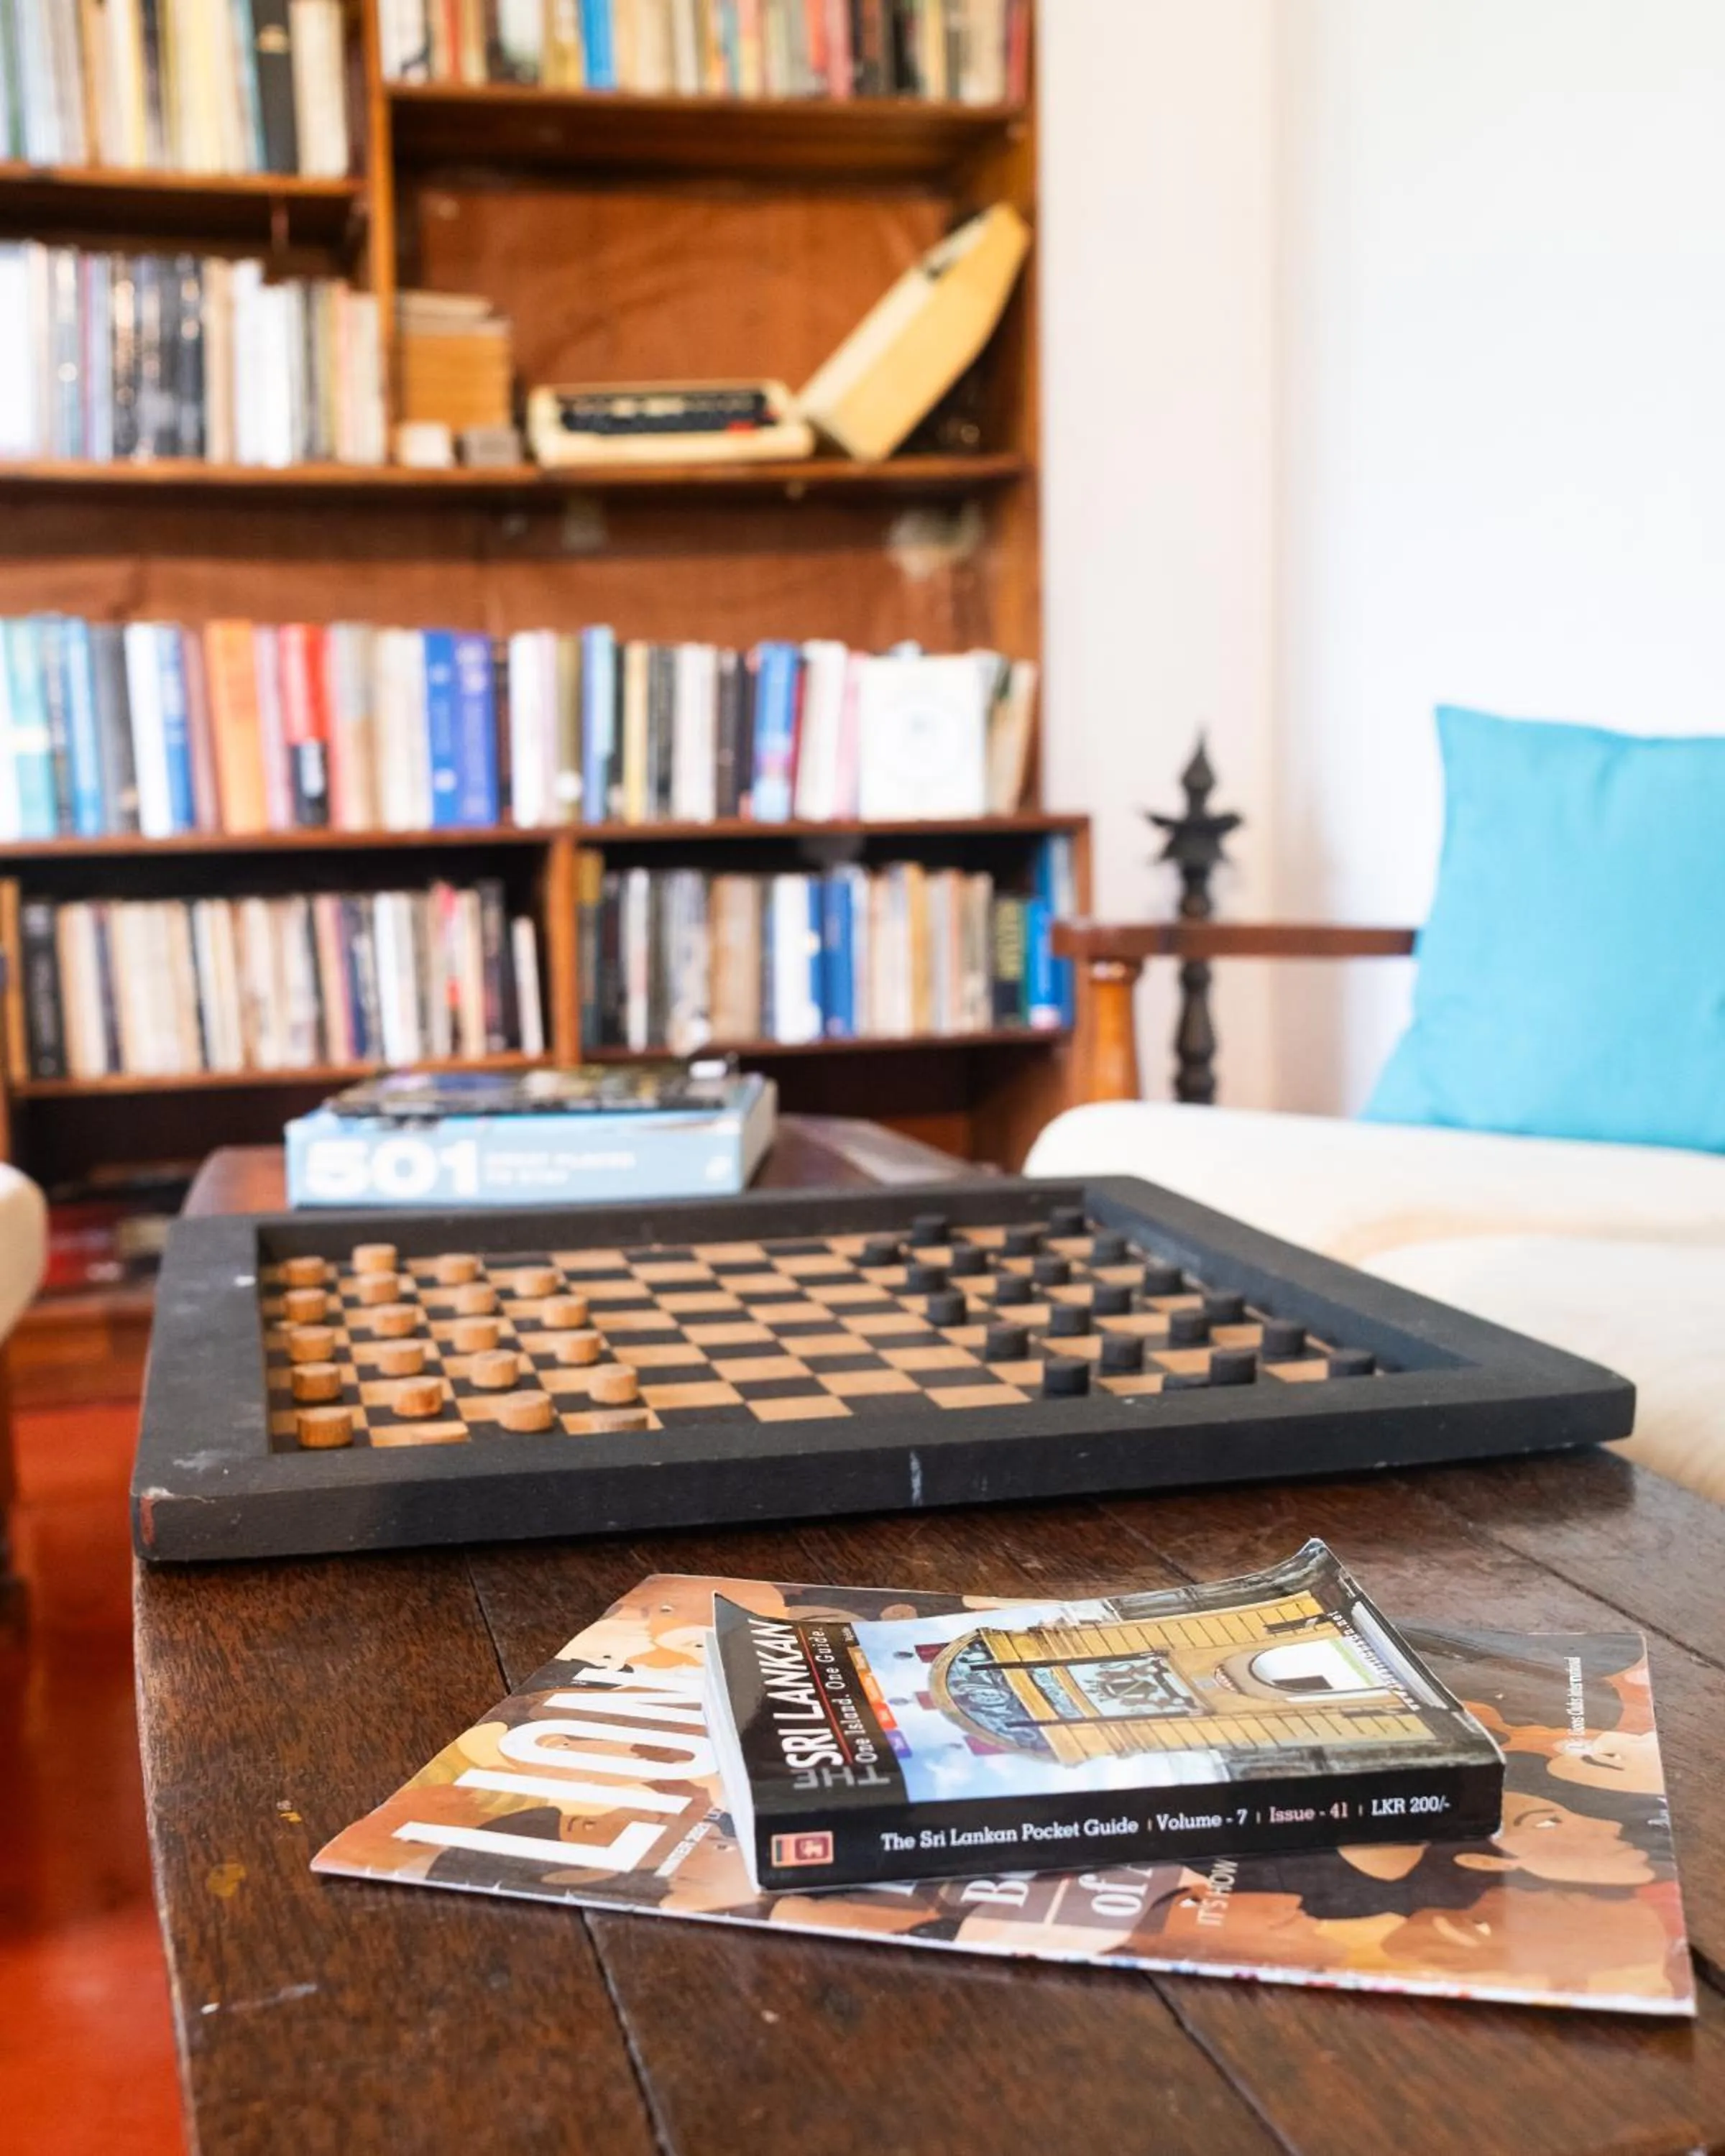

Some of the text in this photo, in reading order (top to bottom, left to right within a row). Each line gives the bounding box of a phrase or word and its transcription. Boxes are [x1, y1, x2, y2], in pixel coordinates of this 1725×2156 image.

[304, 1139, 479, 1199] 501
[809, 1627, 835, 1664] Guide.
[747, 1618, 844, 1769] SRI LANKAN
[825, 1667, 845, 1690] One
[831, 1693, 866, 1734] Island.
[392, 1667, 719, 1873] LION
[854, 1737, 878, 1764] One
[880, 1832, 915, 1851] The
[919, 1830, 946, 1848] Sri
[949, 1826, 1018, 1847] Lankan
[1021, 1821, 1080, 1842] Pocket
[1083, 1816, 1139, 1836] Guide
[1156, 1813, 1222, 1831] Volume
[1269, 1806, 1315, 1823] Issue
[1329, 1802, 1348, 1819] 41
[1371, 1798, 1406, 1816] LKR
[1409, 1795, 1450, 1813] 200/-
[1079, 1873, 1148, 1916] of
[1208, 1858, 1238, 1896] HOW
